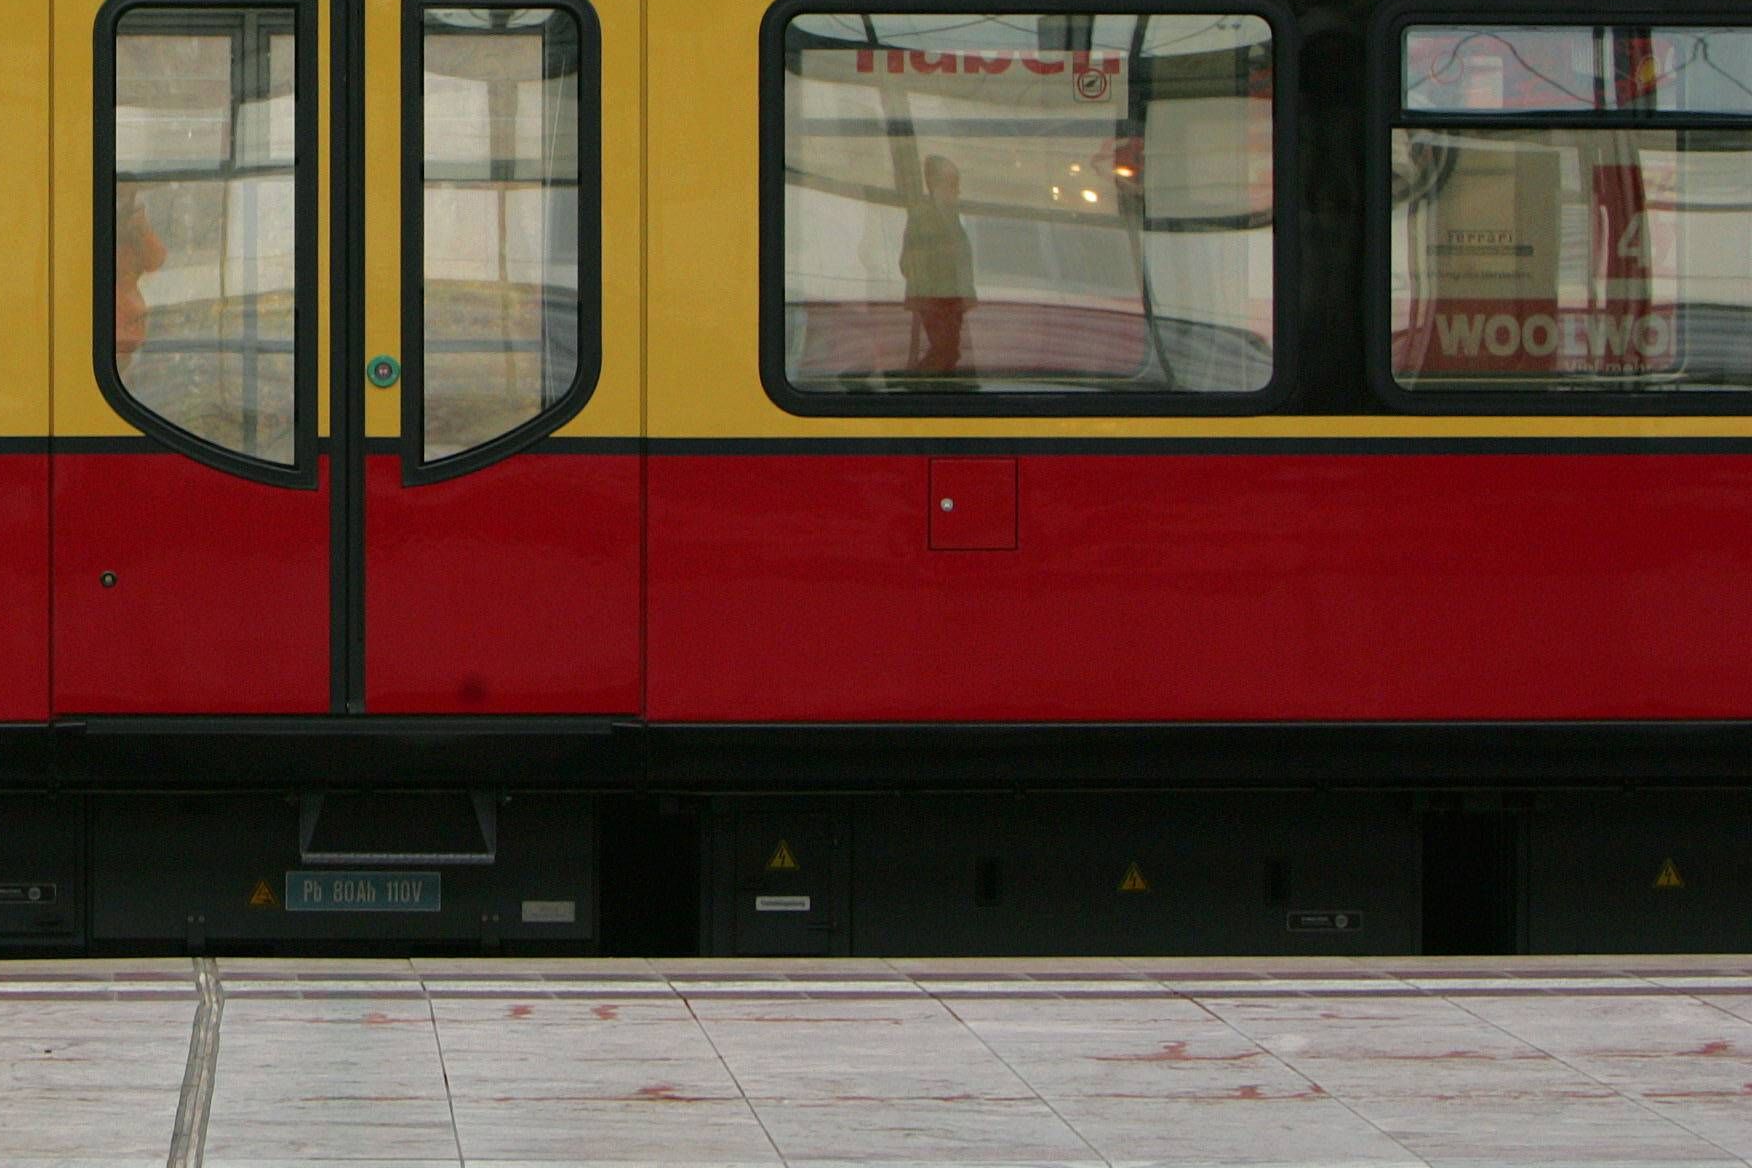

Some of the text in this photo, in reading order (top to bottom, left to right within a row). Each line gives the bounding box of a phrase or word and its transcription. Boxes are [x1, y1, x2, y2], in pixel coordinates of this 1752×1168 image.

[303, 879, 424, 903] Pb 80Ah 110V
